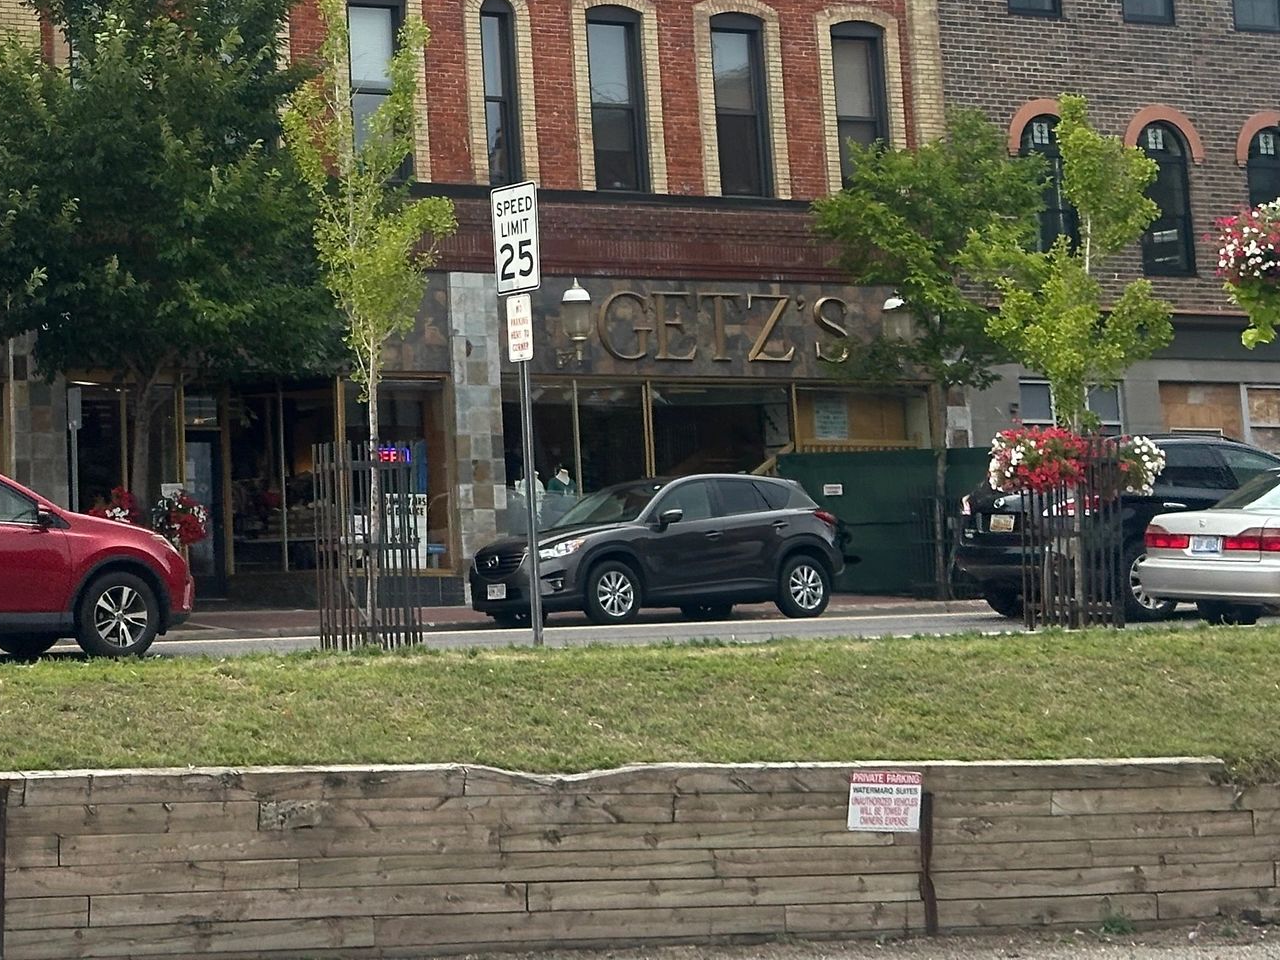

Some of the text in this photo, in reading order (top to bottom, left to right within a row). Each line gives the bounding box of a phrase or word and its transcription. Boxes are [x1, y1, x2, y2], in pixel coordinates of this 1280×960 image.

[496, 195, 532, 218] SPEED
[501, 218, 529, 238] LIMIT
[500, 239, 534, 282] 25
[597, 291, 849, 363] GETZ'S
[853, 773, 920, 784] PRIVATE PARKING
[896, 787, 918, 795] SUITES
[851, 797, 918, 806] UNAUTHORIZED VEHICLES
[860, 807, 909, 816] WILL BE TOWED AT
[885, 817, 908, 826] EXPENSE
